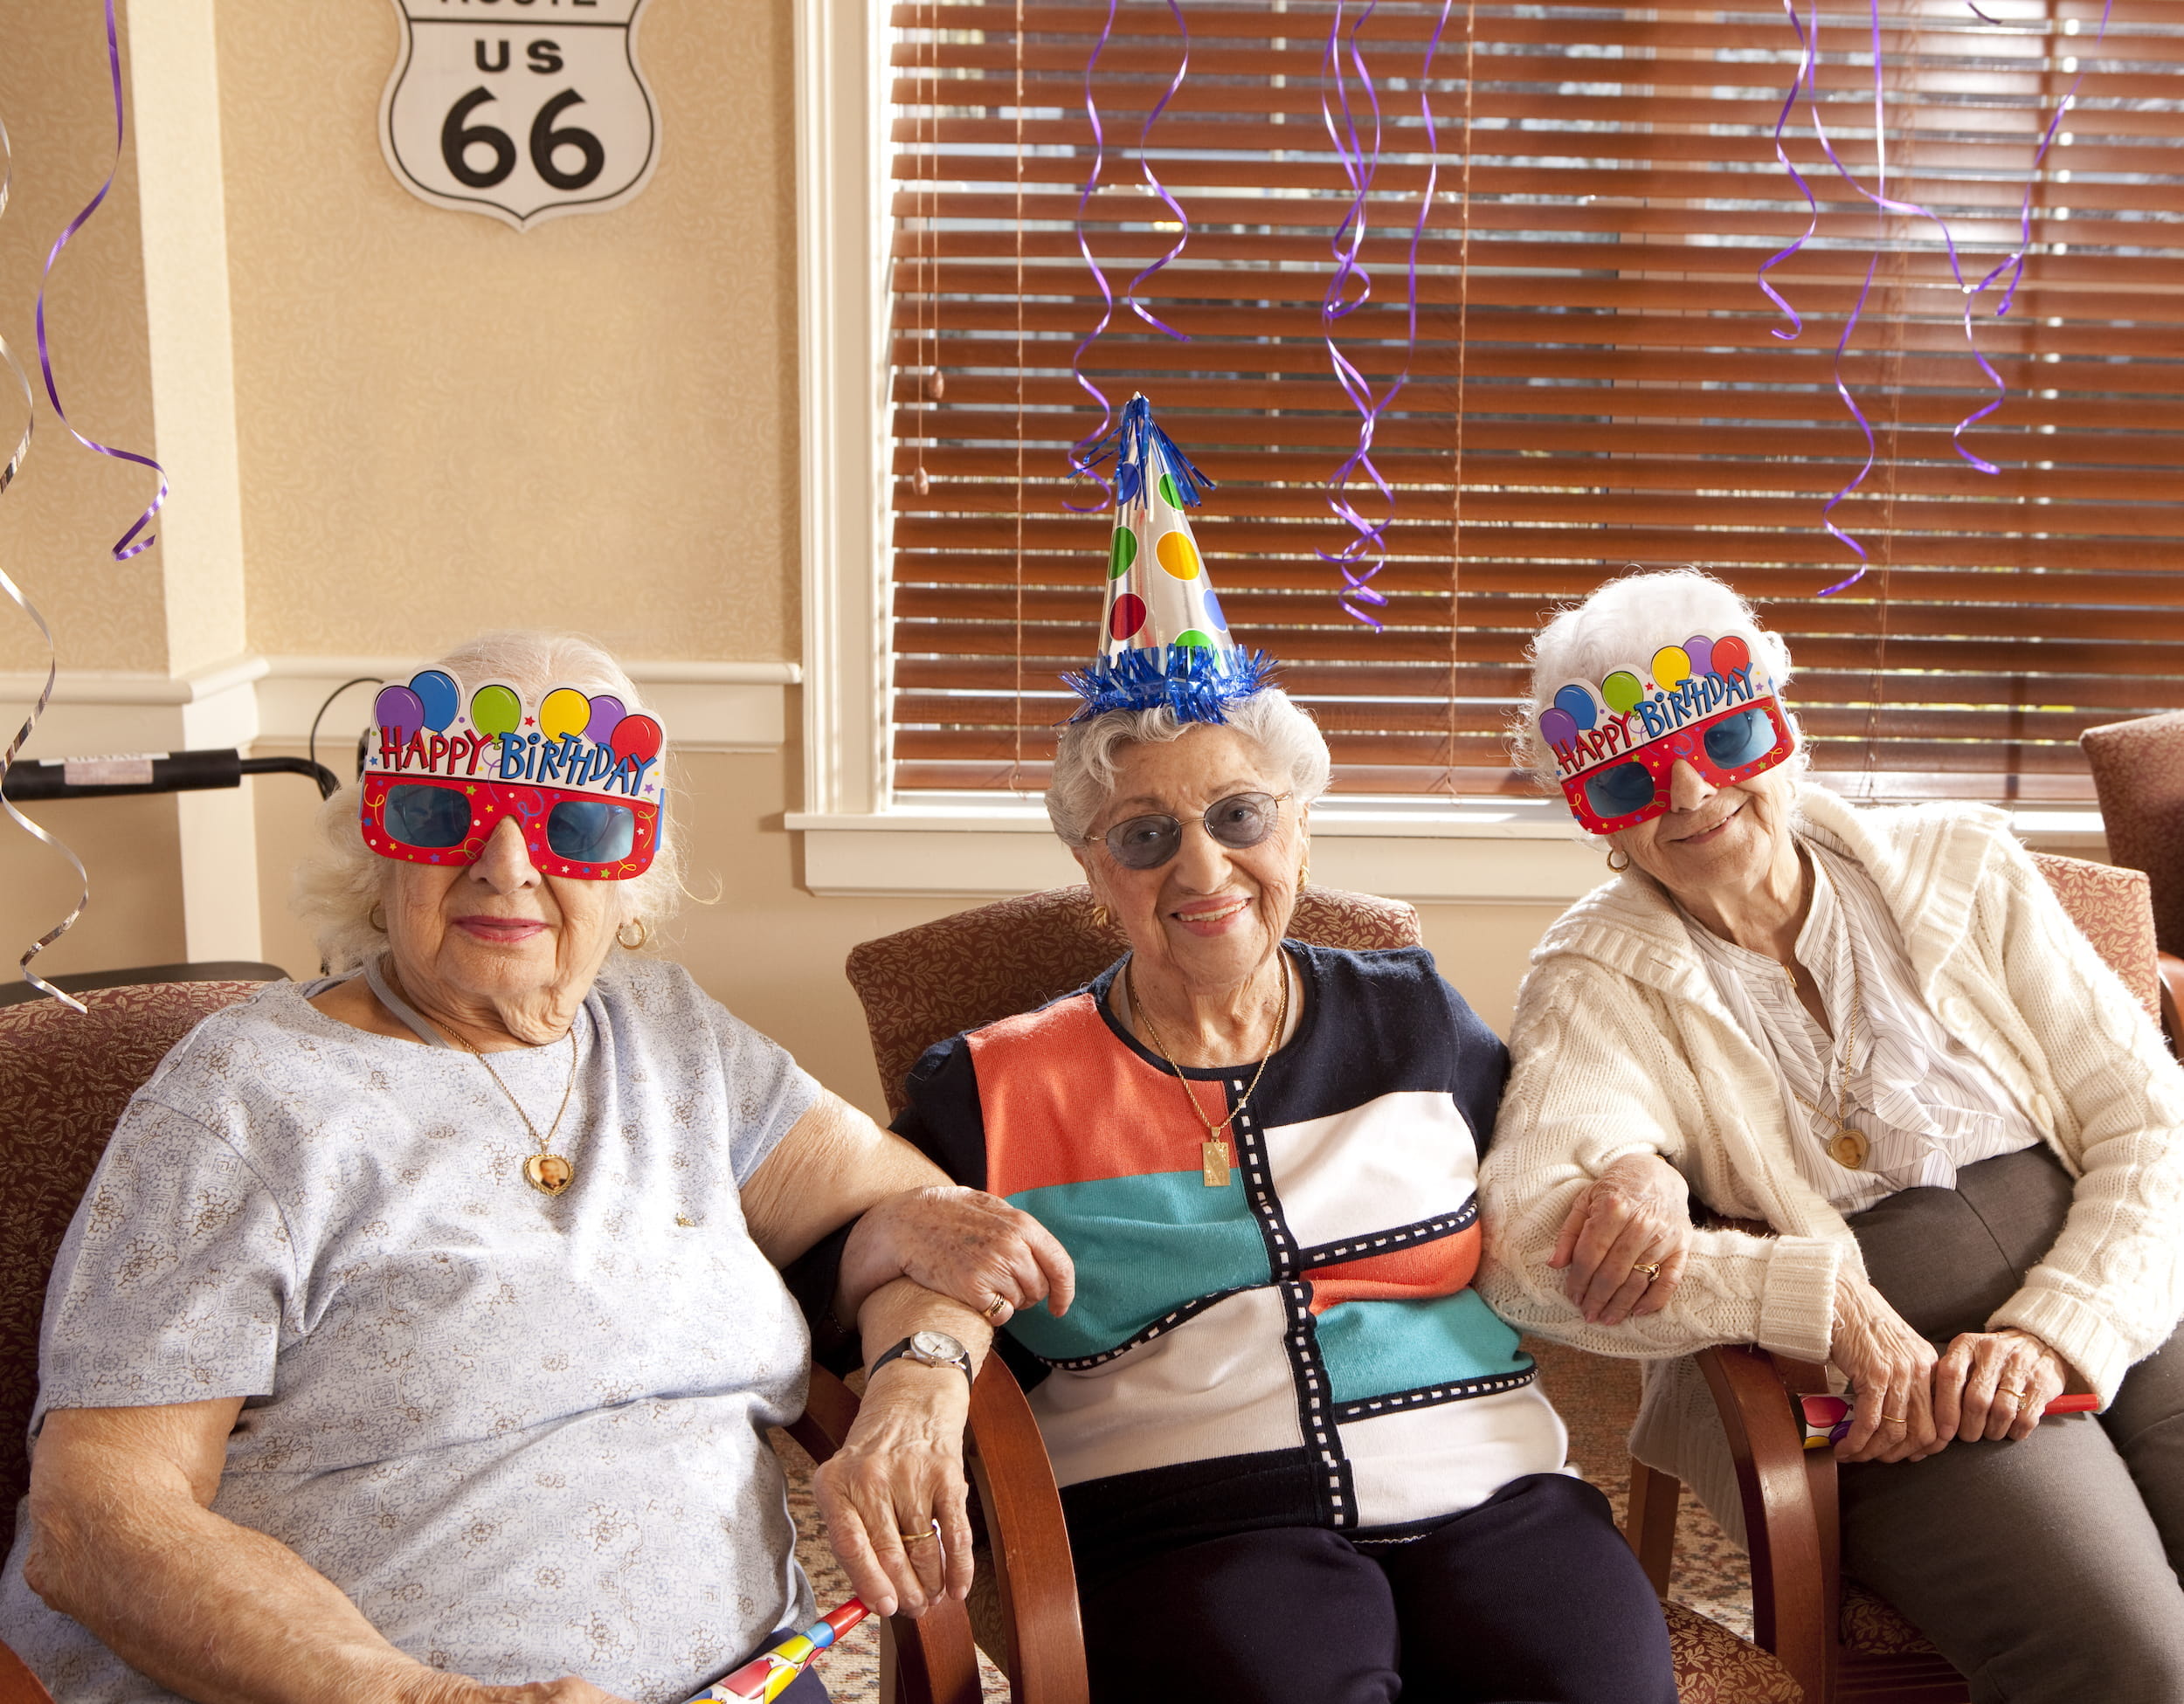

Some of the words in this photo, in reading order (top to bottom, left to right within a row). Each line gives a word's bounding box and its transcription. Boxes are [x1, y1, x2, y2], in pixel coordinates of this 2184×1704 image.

[474, 39, 564, 74] US
[441, 85, 605, 190] 66
[379, 726, 494, 775] HAPPY
[1552, 711, 1631, 775] HAPPY
